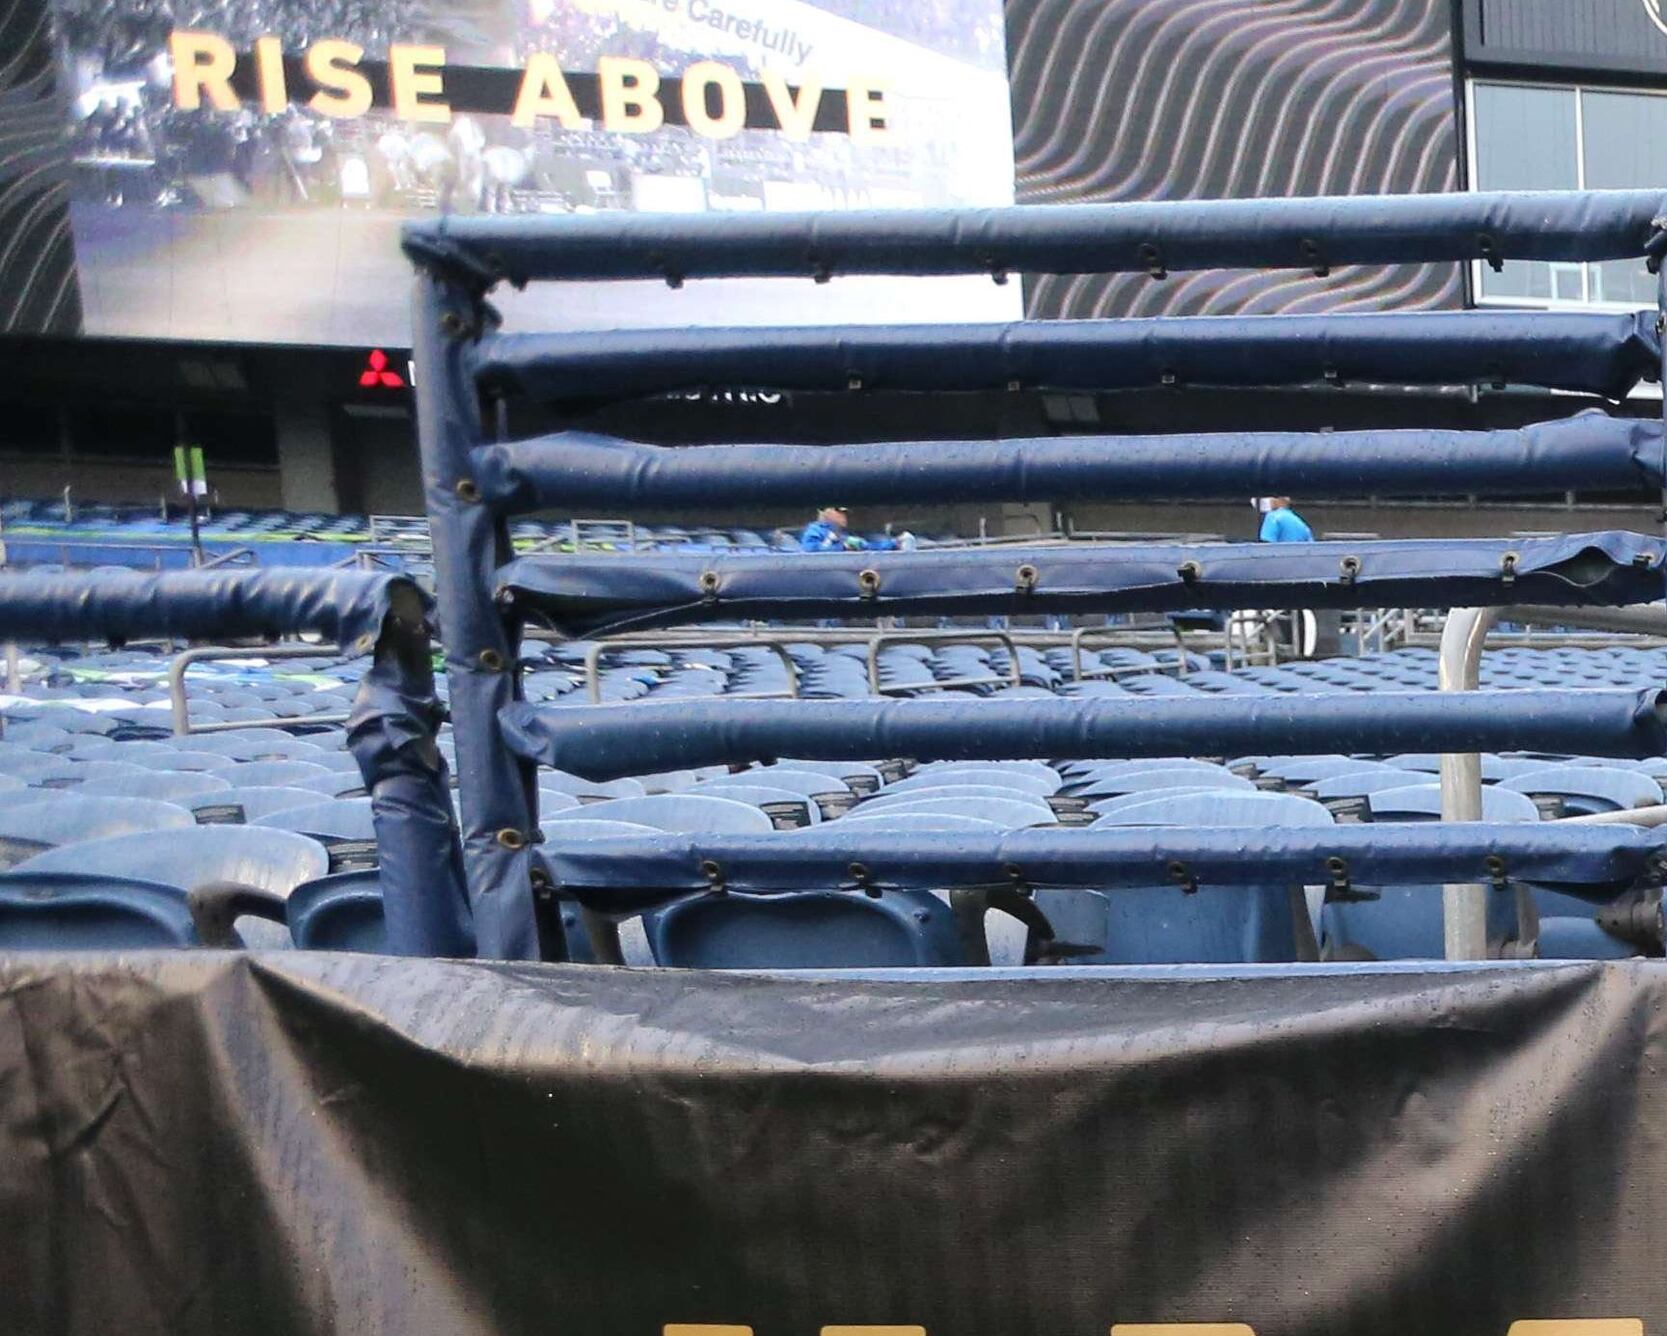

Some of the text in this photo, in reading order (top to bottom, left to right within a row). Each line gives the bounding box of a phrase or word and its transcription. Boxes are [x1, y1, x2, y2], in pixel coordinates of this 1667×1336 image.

[688, 0, 813, 66] Carefully
[169, 30, 894, 144] RISE ABOVE
